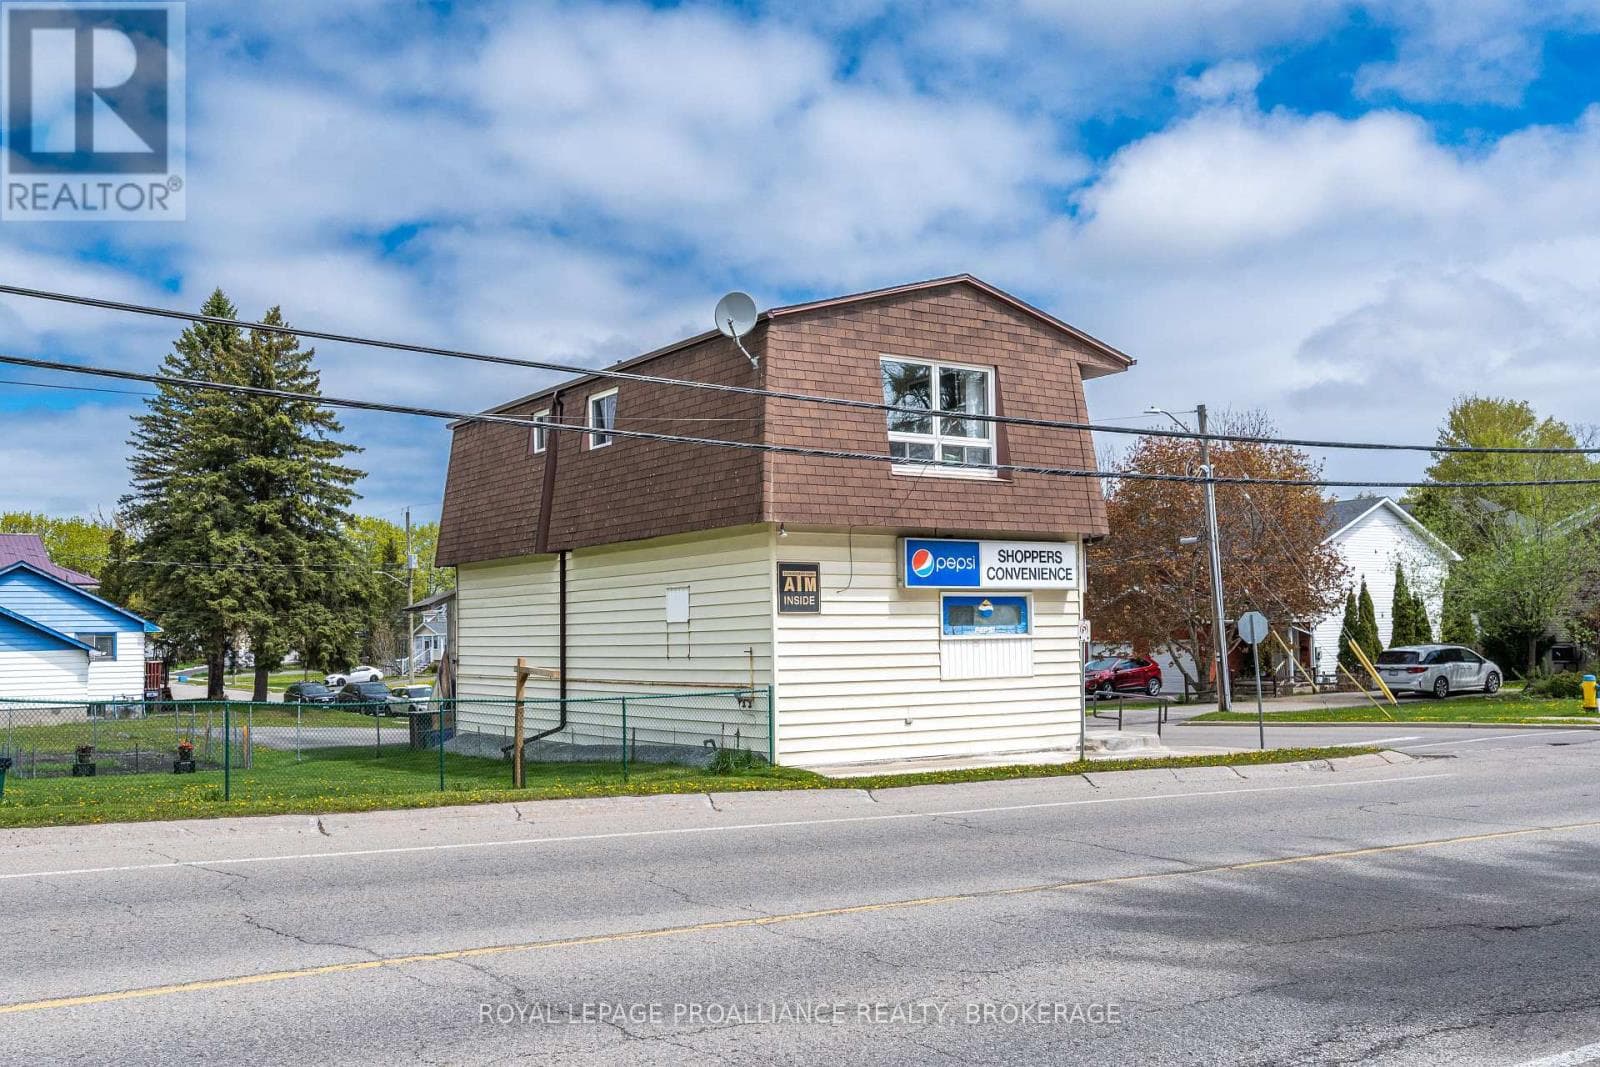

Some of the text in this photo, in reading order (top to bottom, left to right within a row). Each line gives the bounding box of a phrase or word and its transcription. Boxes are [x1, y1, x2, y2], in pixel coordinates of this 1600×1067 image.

[935, 555, 976, 573] pepsi
[997, 549, 1062, 564] SHOPPERS
[986, 566, 1073, 581] CONVENIENCE
[783, 571, 817, 592] ATM
[783, 595, 816, 606] INSIDE
